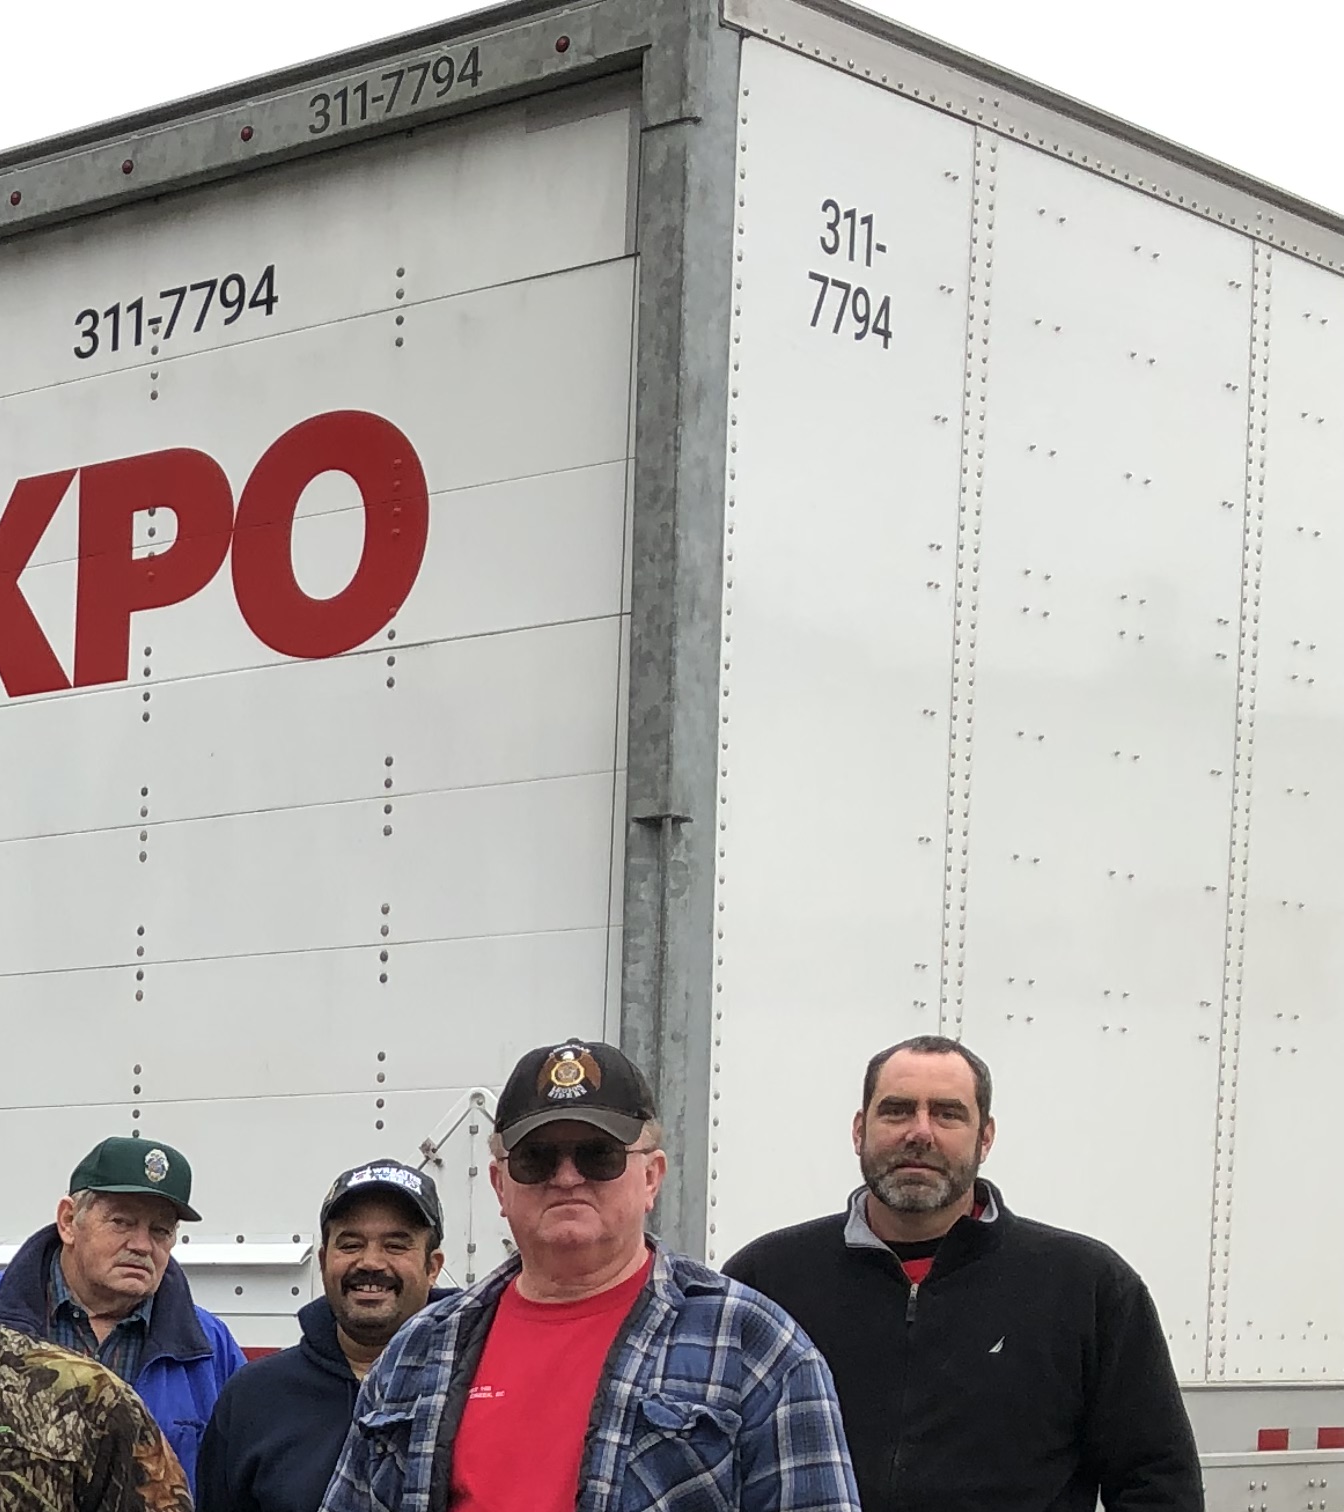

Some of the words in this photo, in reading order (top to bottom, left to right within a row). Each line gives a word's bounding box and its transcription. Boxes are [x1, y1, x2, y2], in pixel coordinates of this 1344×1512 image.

[308, 45, 483, 134] 311-7794
[819, 198, 887, 268] 311-
[73, 264, 279, 359] 311-7794
[808, 270, 892, 350] 7794
